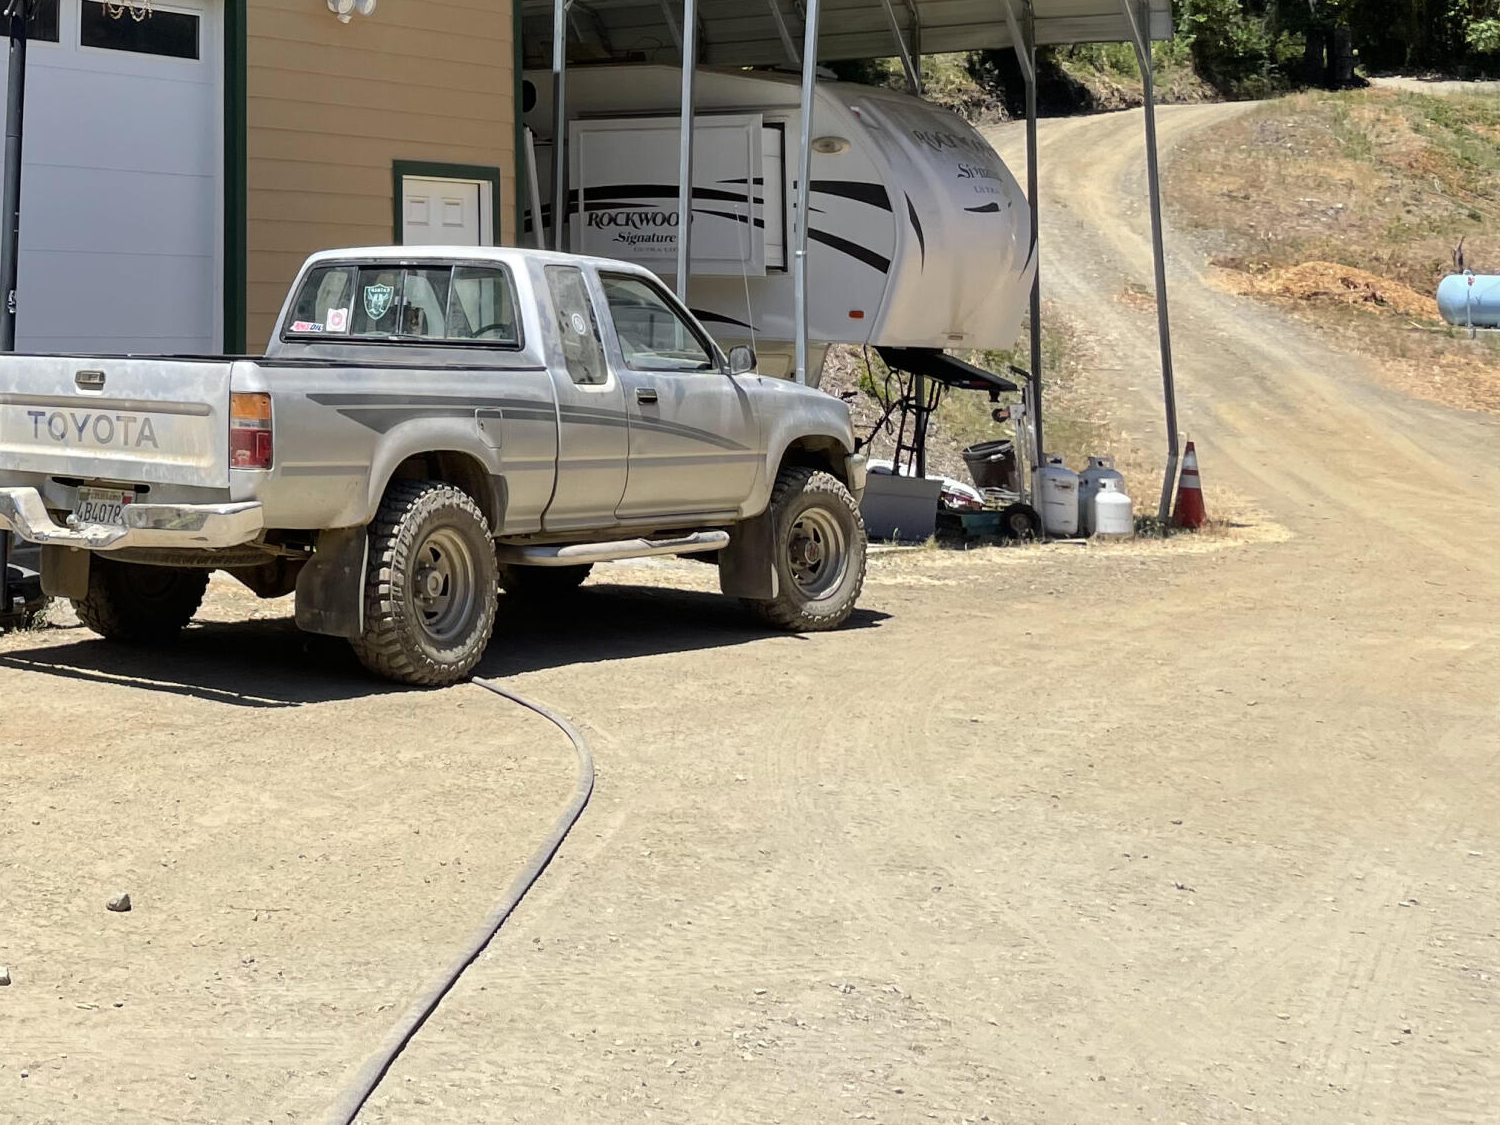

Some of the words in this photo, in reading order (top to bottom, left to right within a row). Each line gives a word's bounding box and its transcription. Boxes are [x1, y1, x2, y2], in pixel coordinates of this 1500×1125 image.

[587, 211, 694, 230] ROCKWOO
[611, 231, 677, 246] Signature
[26, 410, 160, 449] TOYOTA
[76, 501, 125, 524] 4B4078
